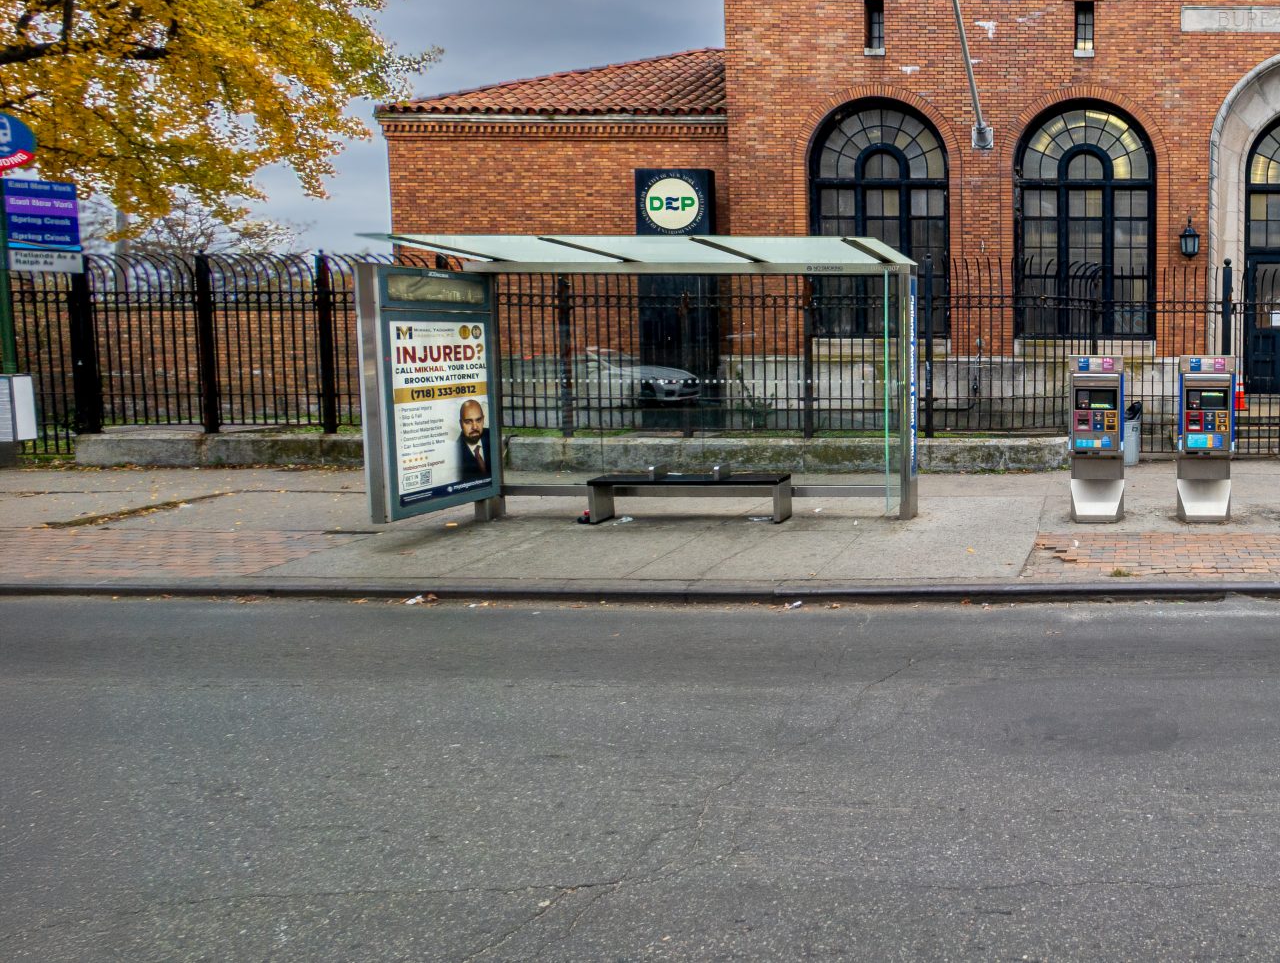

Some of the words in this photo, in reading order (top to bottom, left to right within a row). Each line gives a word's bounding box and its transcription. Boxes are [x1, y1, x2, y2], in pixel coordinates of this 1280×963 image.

[649, 196, 696, 212] DEP
[396, 343, 483, 364] INJURED?
[404, 375, 445, 384] BROOKLYN
[445, 373, 480, 381] ATTORNEY
[411, 388, 435, 400] (718)
[437, 385, 477, 396] 333-0812
